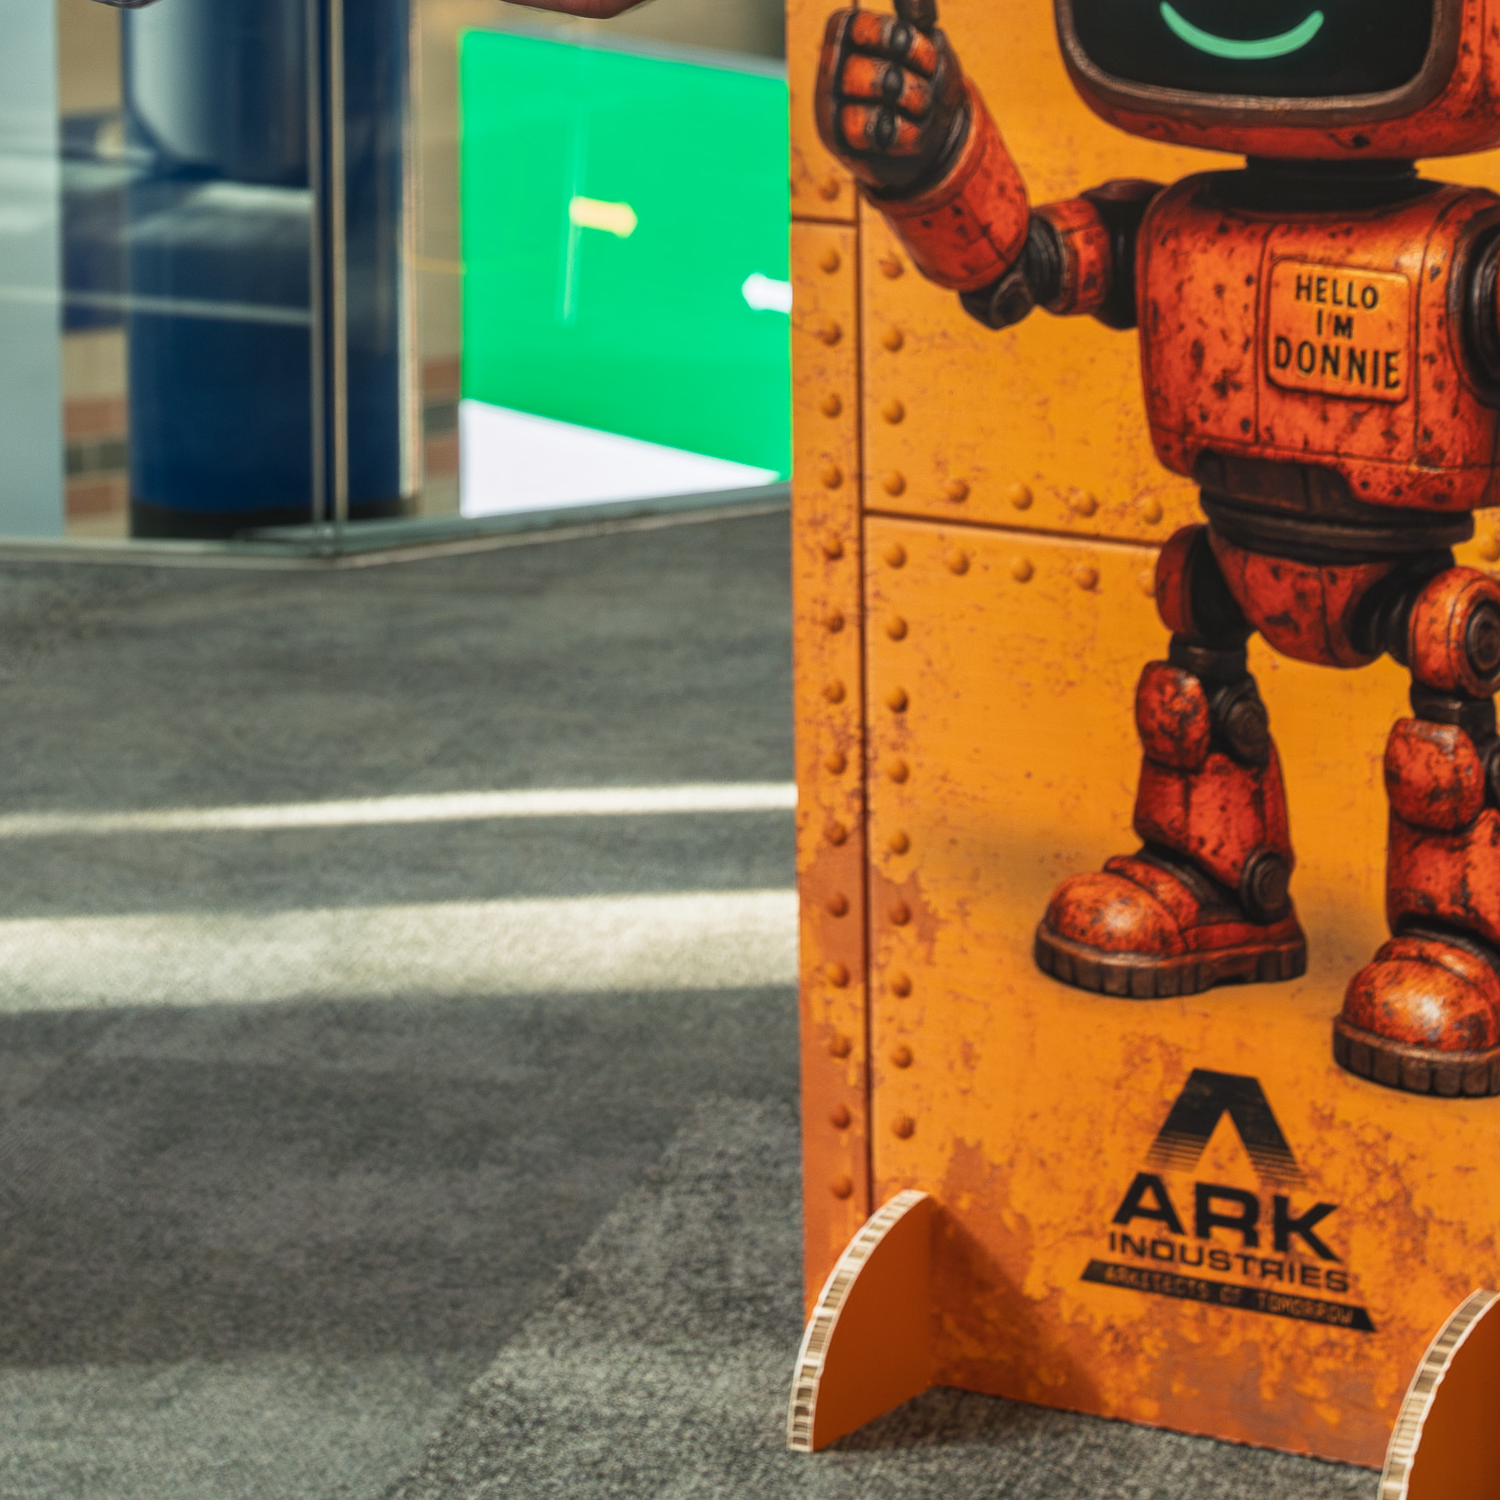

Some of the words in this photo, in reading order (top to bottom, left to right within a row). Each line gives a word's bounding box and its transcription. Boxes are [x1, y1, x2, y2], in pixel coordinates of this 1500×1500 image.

[1296, 275, 1378, 309] HELLO
[1275, 335, 1400, 389] DONNIE
[1112, 1172, 1341, 1262] ARK
[1109, 1231, 1350, 1292] INDUSTRIES
